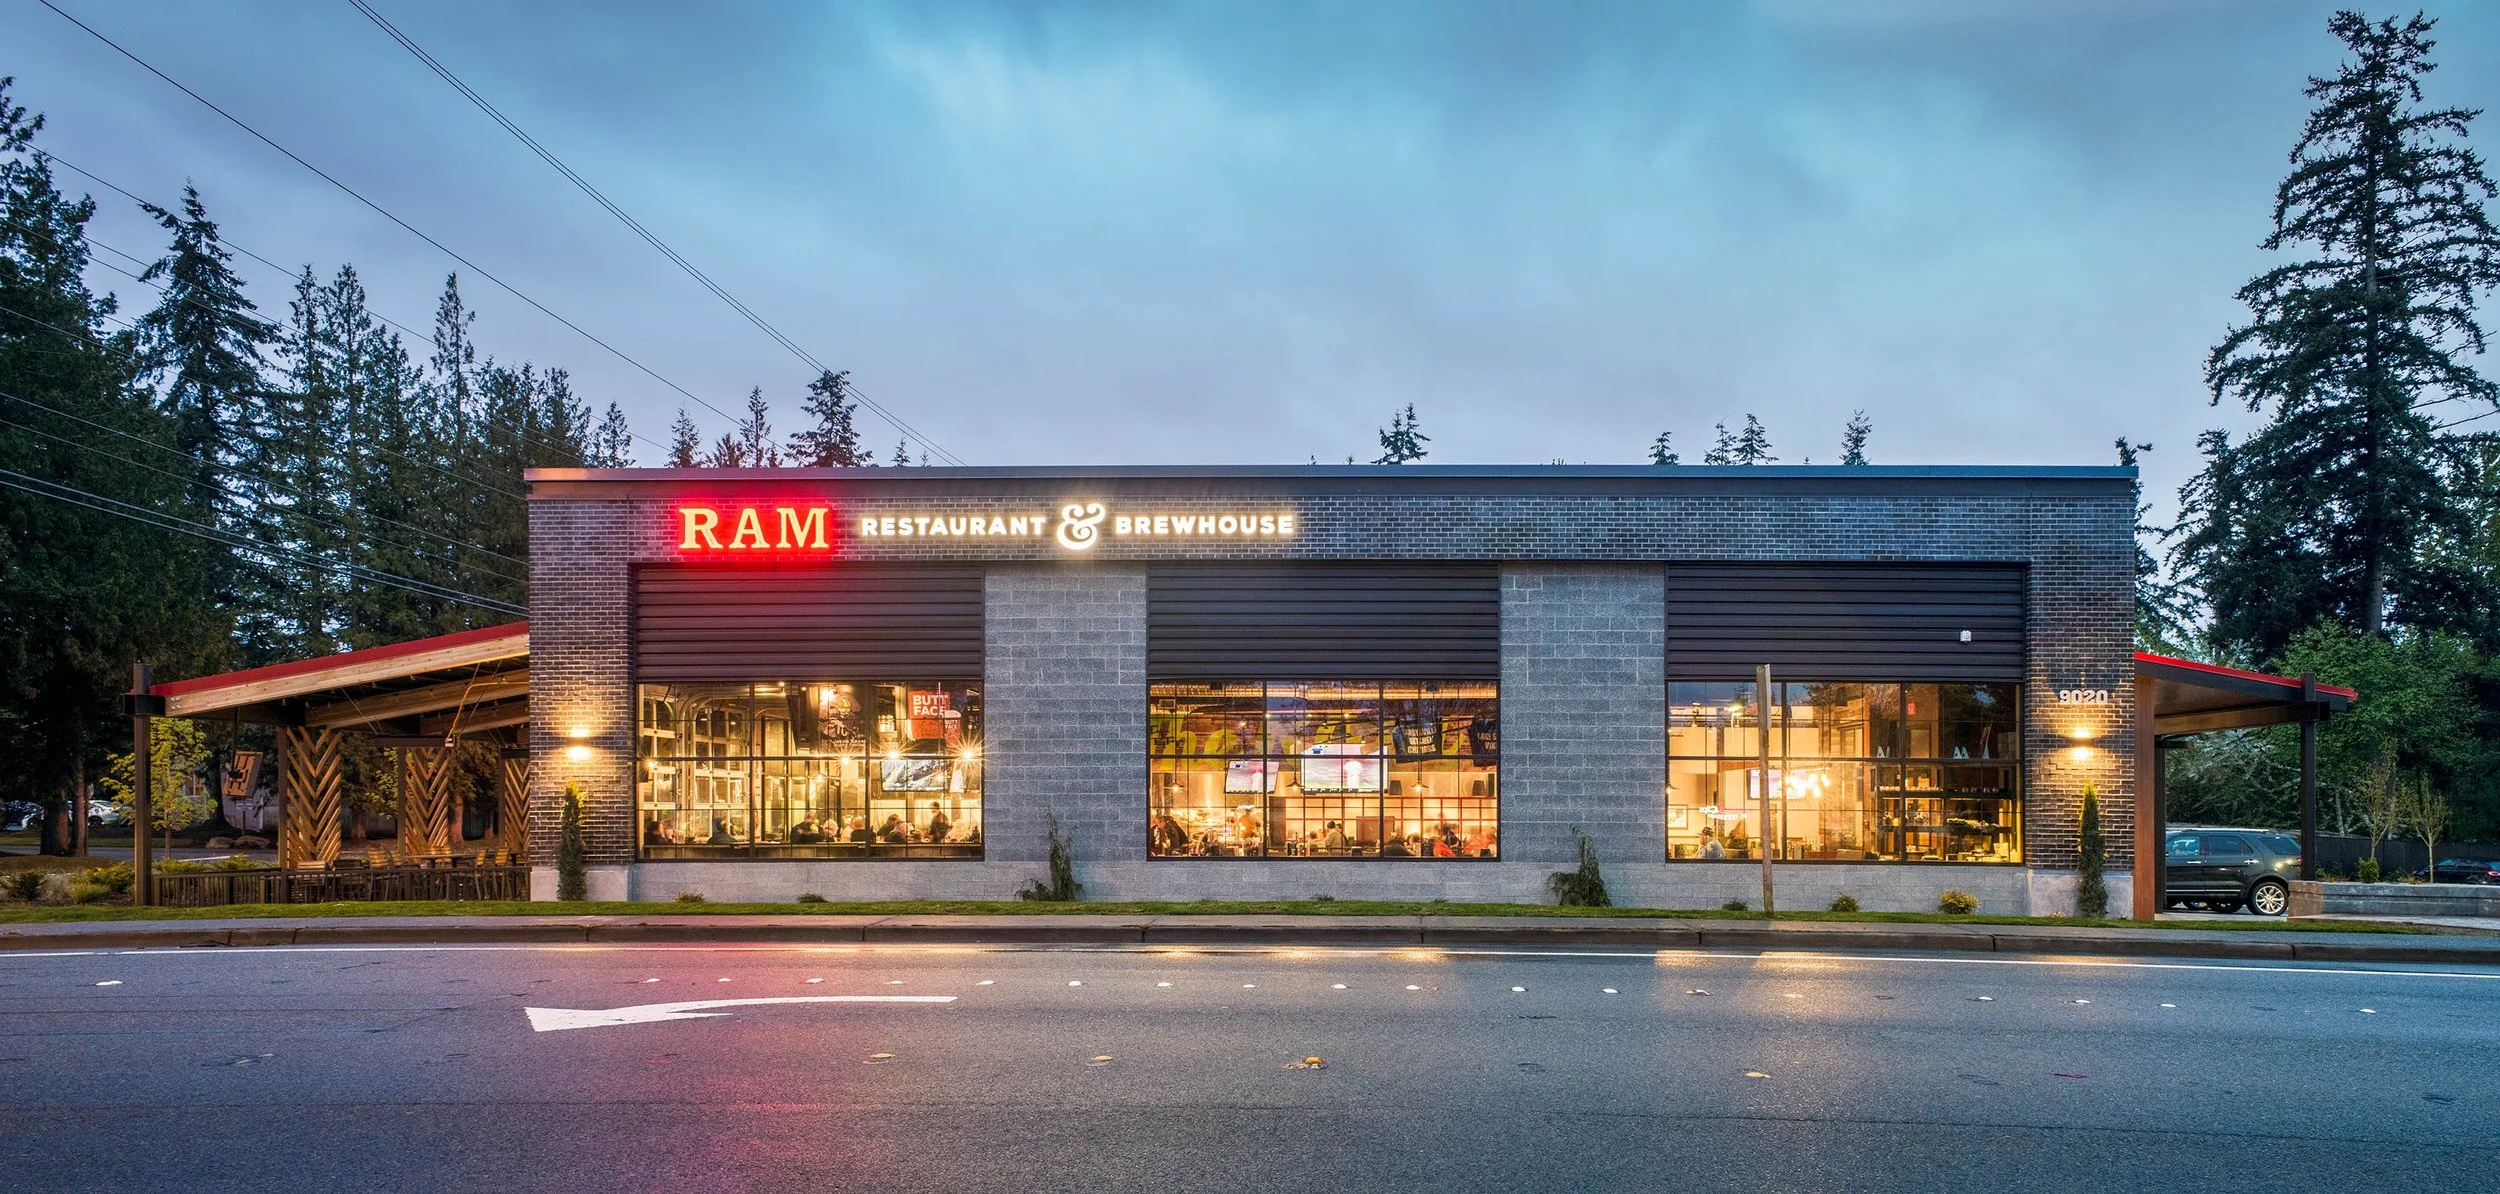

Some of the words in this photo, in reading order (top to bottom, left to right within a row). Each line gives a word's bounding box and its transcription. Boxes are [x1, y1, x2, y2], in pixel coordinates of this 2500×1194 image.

[679, 507, 829, 549] RAM
[861, 516, 1047, 536] RESTAURANT
[1057, 502, 1105, 550] &
[1115, 515, 1294, 535] BREWHOUSE
[913, 694, 948, 706] BUTT
[2059, 689, 2108, 704] 9020
[913, 705, 946, 717] FACE
